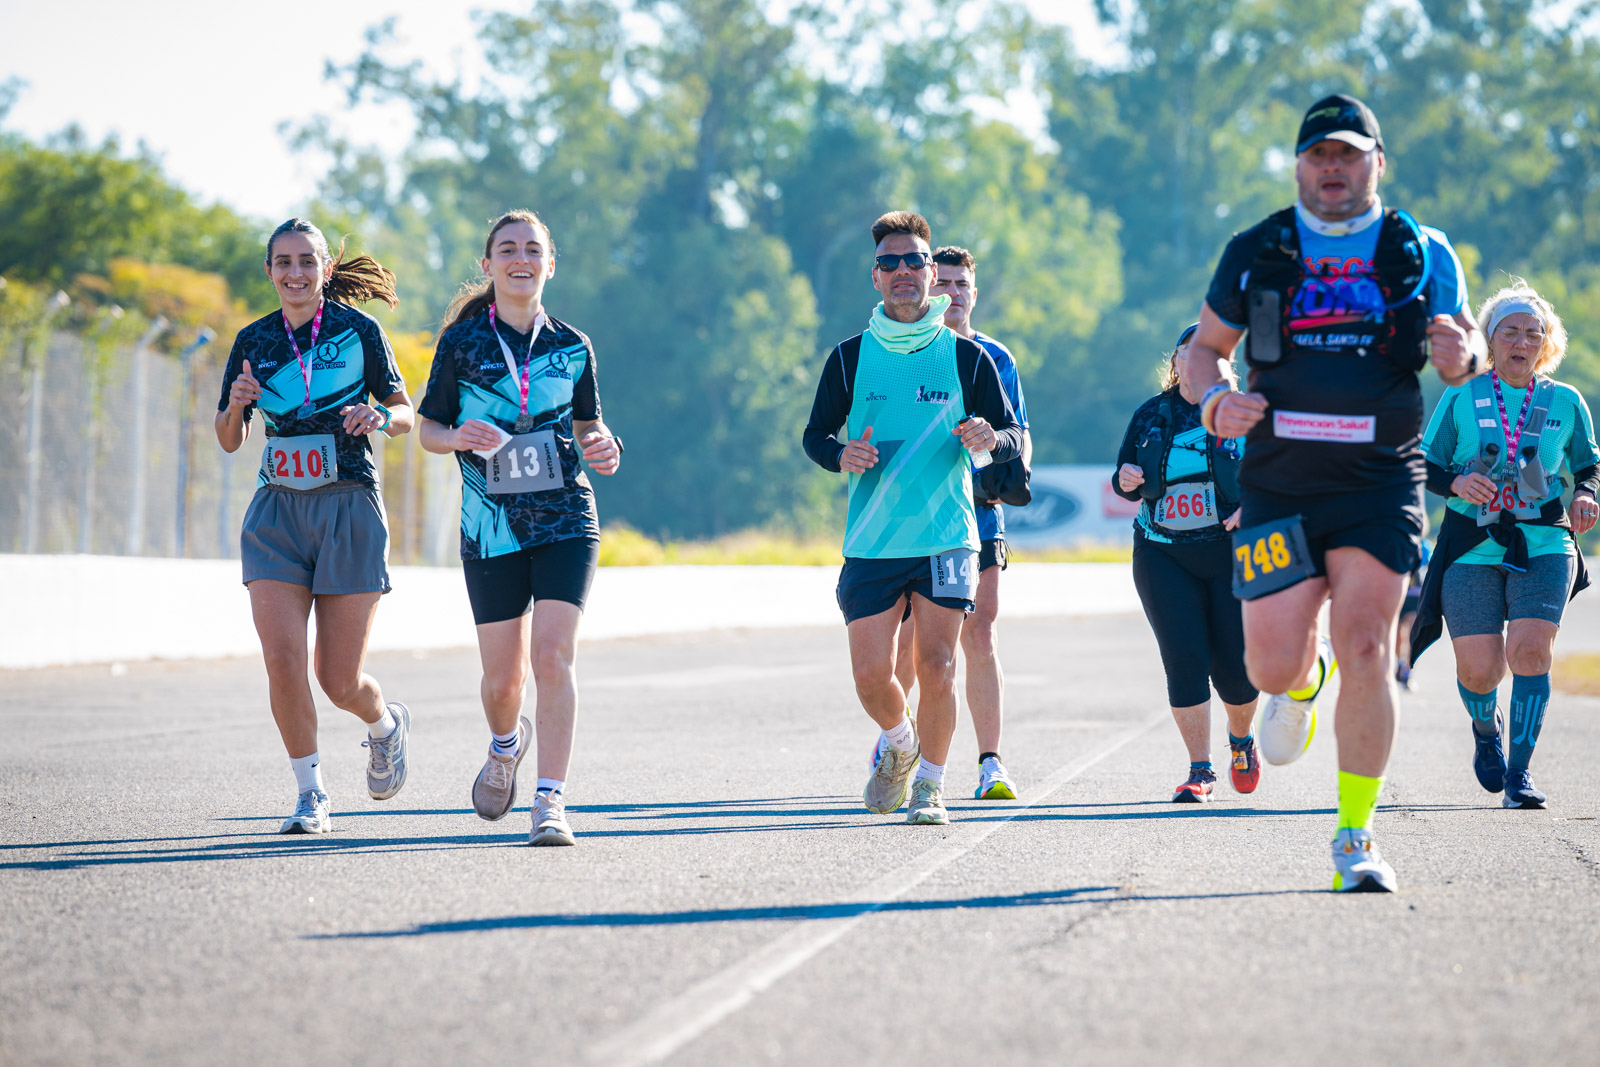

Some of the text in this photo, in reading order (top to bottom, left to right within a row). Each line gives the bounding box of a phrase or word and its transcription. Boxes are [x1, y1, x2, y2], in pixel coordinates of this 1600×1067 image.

[258, 361, 278, 369] INVICTO
[325, 361, 346, 370] TEAM
[917, 386, 950, 402] km
[1337, 418, 1370, 431] Salud
[267, 446, 277, 479] TIEMPO
[273, 448, 323, 478] 210
[321, 445, 331, 479] EXACTO
[507, 446, 541, 479] 13
[543, 442, 555, 479] EXACTO
[1165, 492, 1204, 520] 266
[935, 555, 945, 587] TIEMPO
[1235, 531, 1291, 582] 748
